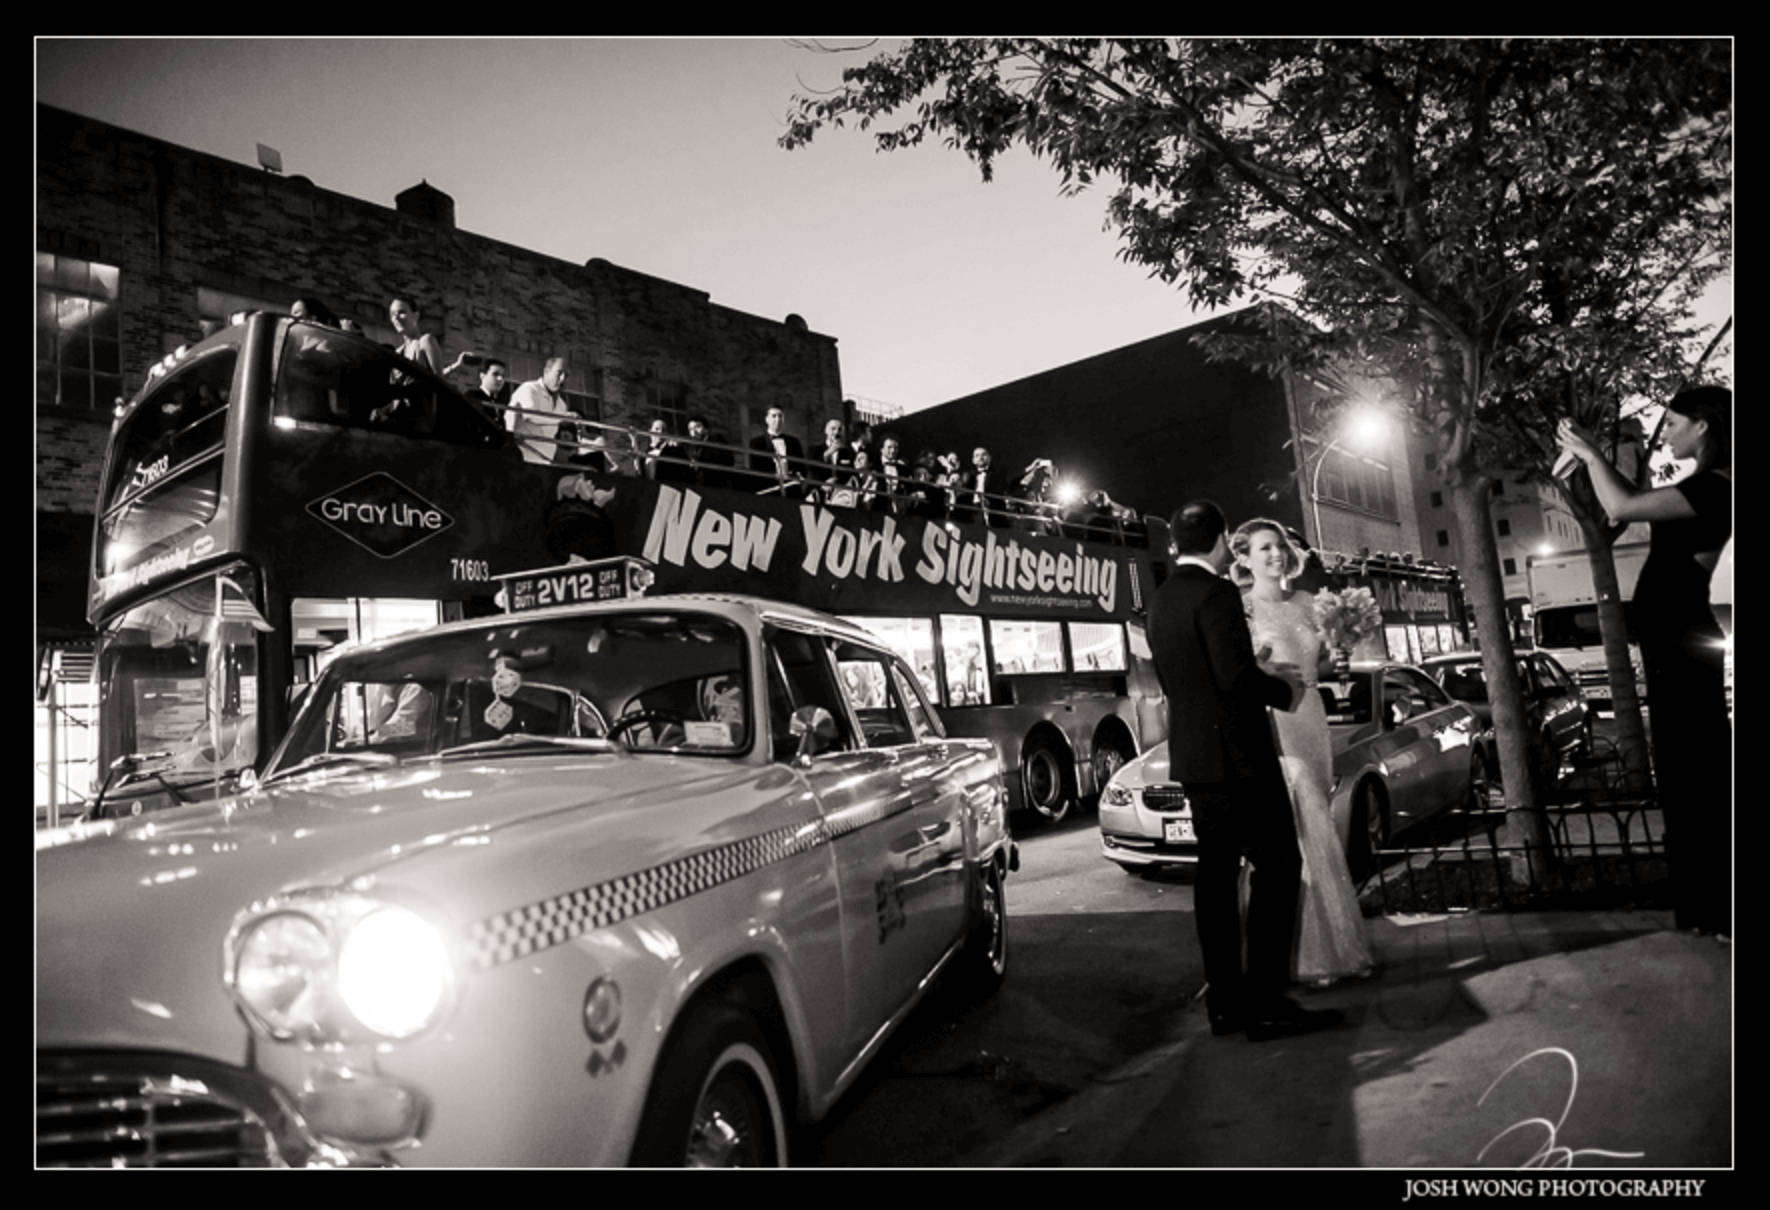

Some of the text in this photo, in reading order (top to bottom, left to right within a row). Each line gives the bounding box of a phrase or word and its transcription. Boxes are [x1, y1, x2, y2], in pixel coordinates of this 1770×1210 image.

[321, 498, 442, 529] Gray Line
[642, 484, 1118, 613] New York Sightseeing
[451, 559, 489, 581] 71603
[599, 570, 618, 583] OFF
[515, 581, 533, 594] OFF
[538, 573, 594, 604] 2V12
[598, 584, 622, 598] DUTY
[514, 595, 535, 609] DUTY
